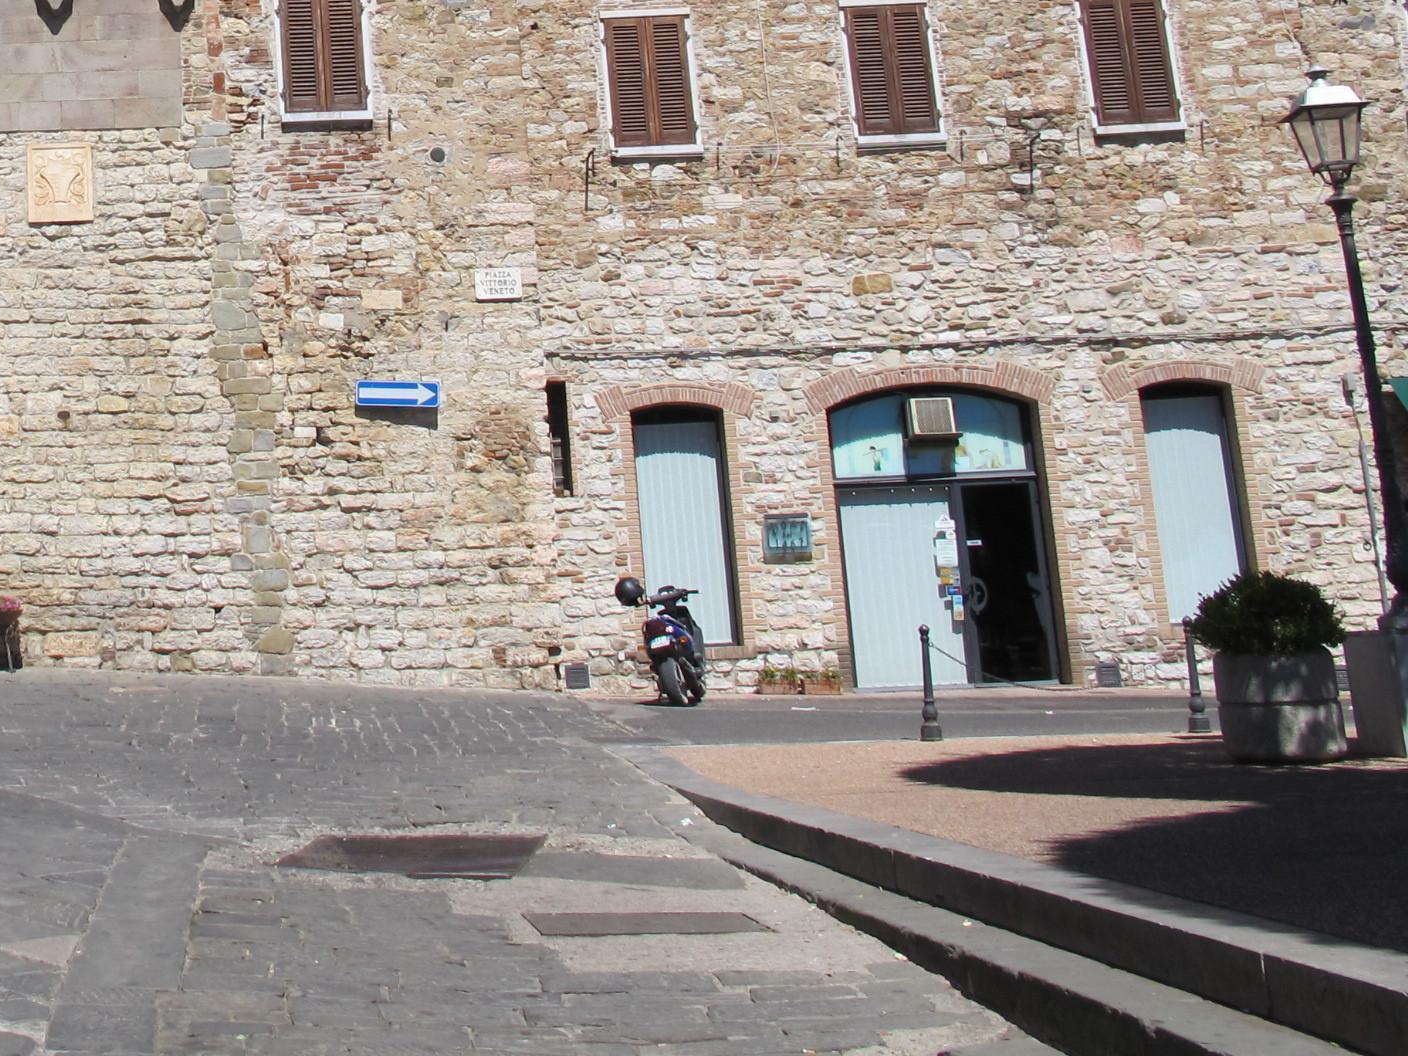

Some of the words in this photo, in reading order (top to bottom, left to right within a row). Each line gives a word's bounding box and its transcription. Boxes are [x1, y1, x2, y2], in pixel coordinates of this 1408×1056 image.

[484, 271, 512, 279] PIAZZA
[479, 279, 517, 287] VITTORIO
[483, 287, 515, 295] VENETO
